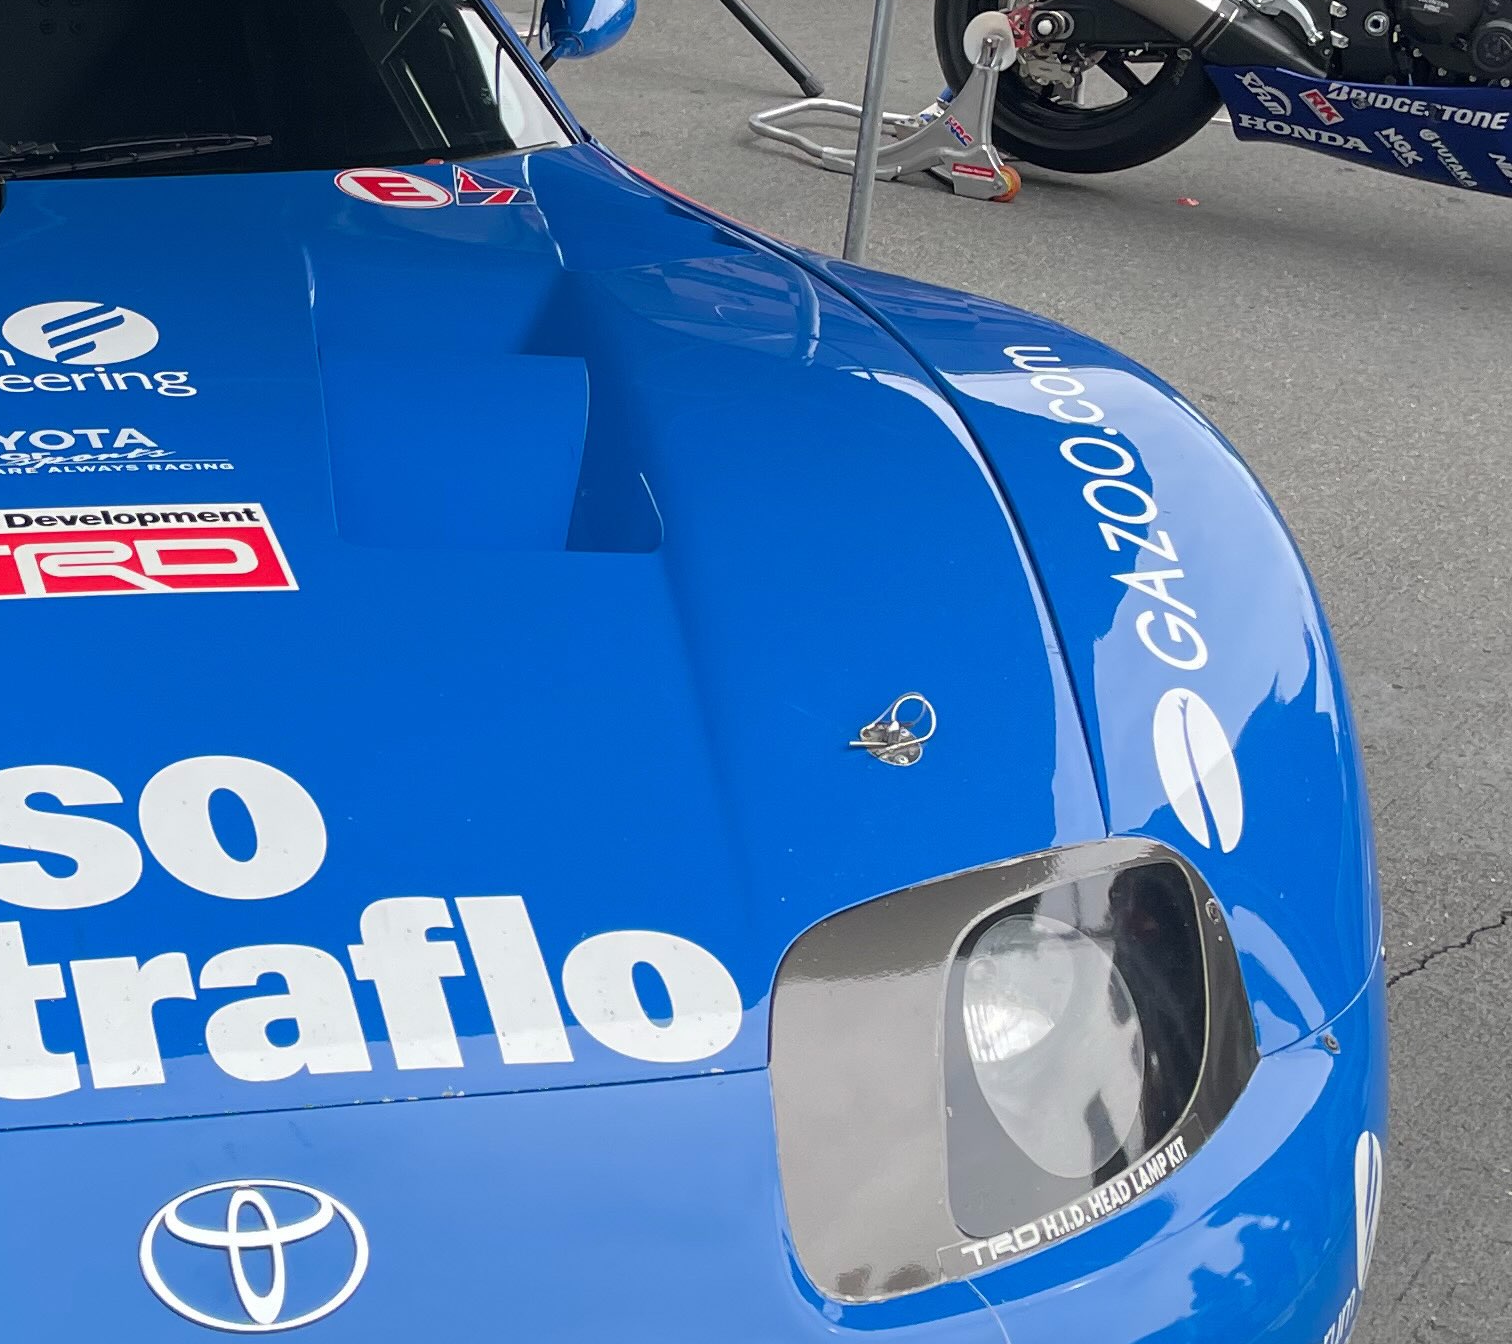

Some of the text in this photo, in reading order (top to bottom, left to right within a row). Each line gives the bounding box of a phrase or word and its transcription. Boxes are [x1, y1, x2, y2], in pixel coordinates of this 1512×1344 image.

[1300, 89, 1344, 126] RK
[1326, 82, 1511, 131] BRIDGETONE
[1239, 113, 1373, 154] HONDA
[1380, 127, 1424, 166] NGK
[48, 463, 139, 475] ALWAYS
[146, 462, 235, 472] RACING
[5, 506, 262, 531] Development
[1002, 345, 1209, 671] GAZOO.com
[960, 1222, 1042, 1266] TRD
[1088, 1180, 1132, 1219] HEAD
[1129, 1153, 1168, 1195] LAMP
[1166, 1135, 1189, 1170] KIT
